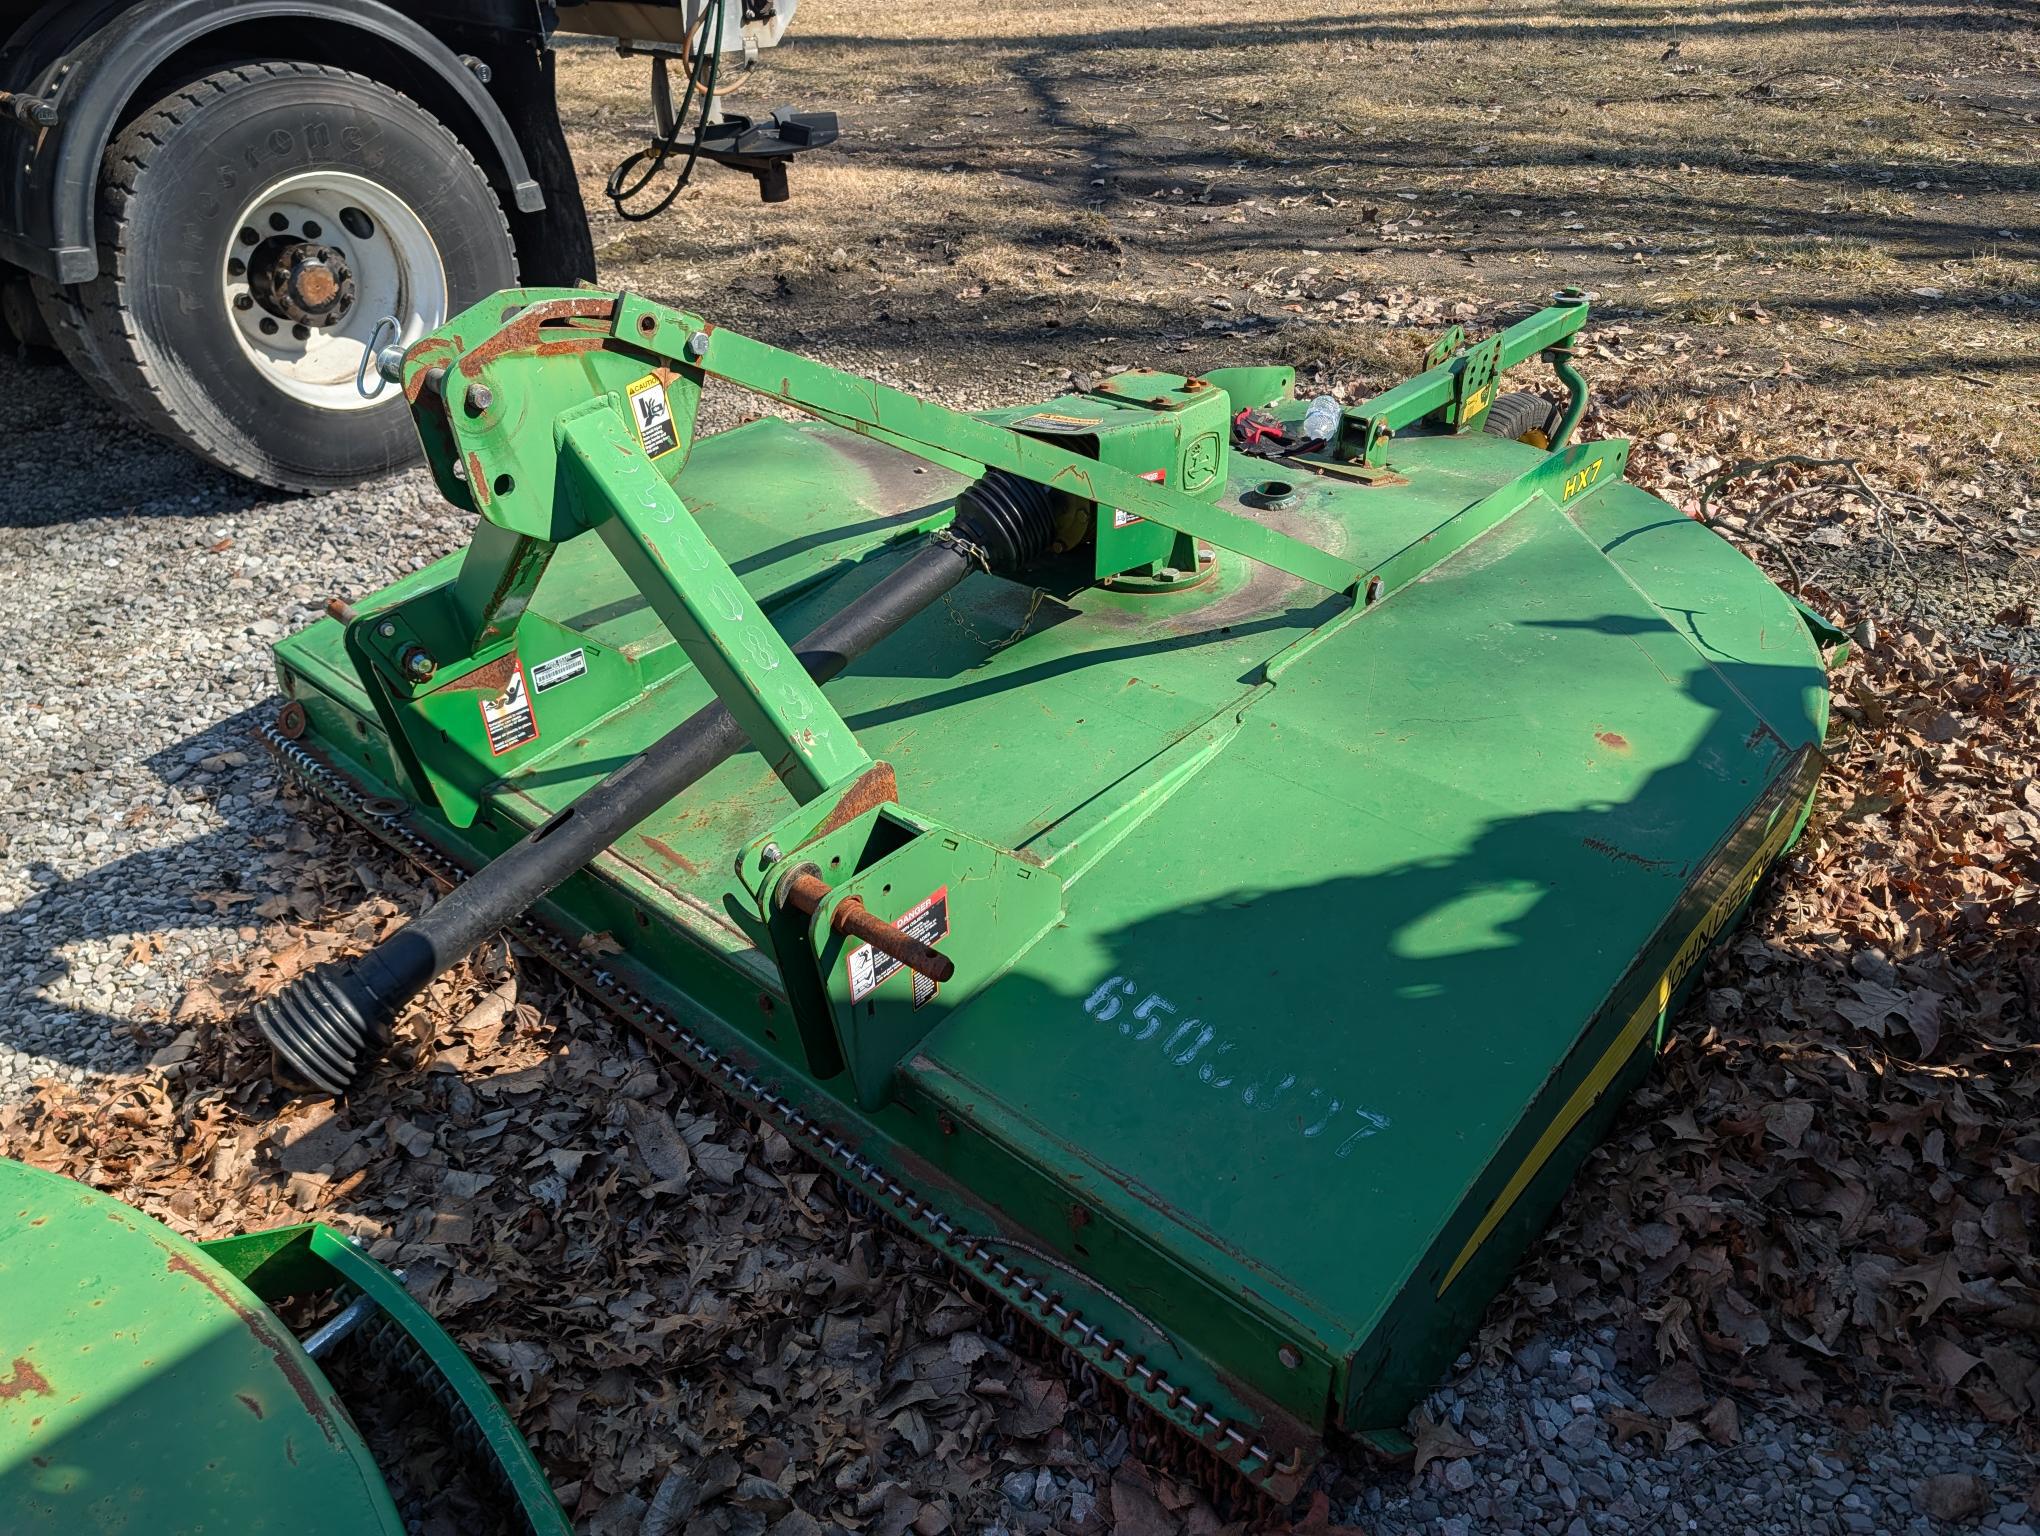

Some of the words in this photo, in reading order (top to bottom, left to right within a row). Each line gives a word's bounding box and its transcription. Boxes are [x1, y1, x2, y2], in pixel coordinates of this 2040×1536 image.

[1562, 457, 1603, 502] HX7
[896, 898, 931, 929] DANGER
[1667, 920, 1714, 997] JOHN
